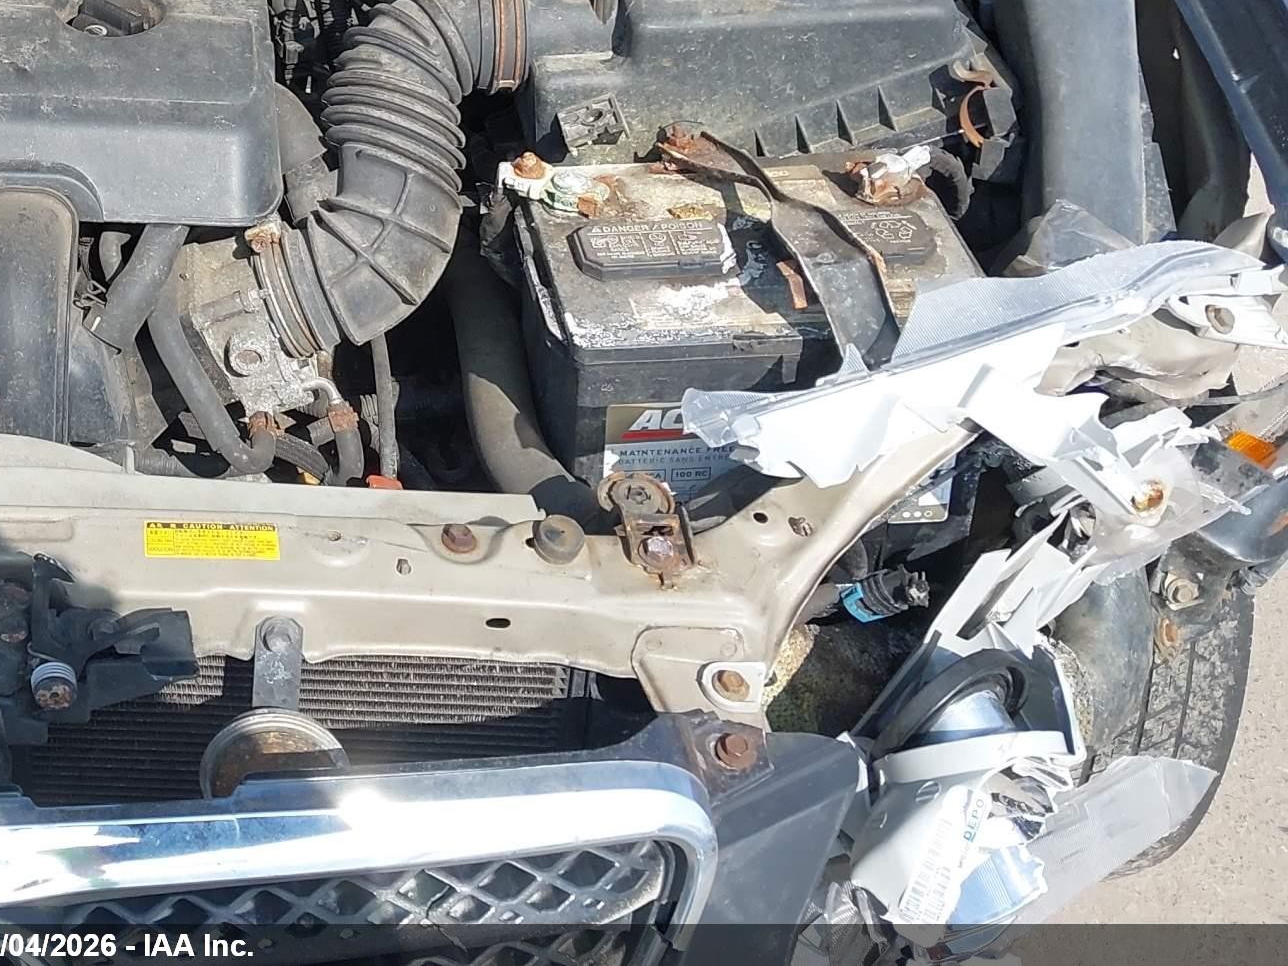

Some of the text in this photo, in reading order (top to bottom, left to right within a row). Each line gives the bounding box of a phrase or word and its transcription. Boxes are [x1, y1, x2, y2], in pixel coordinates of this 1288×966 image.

[603, 224, 649, 233] DANGER
[662, 222, 703, 230] POISON
[619, 447, 702, 457] MAINTENANCE
[675, 470, 692, 478] 100
[963, 798, 985, 843] DEPO
